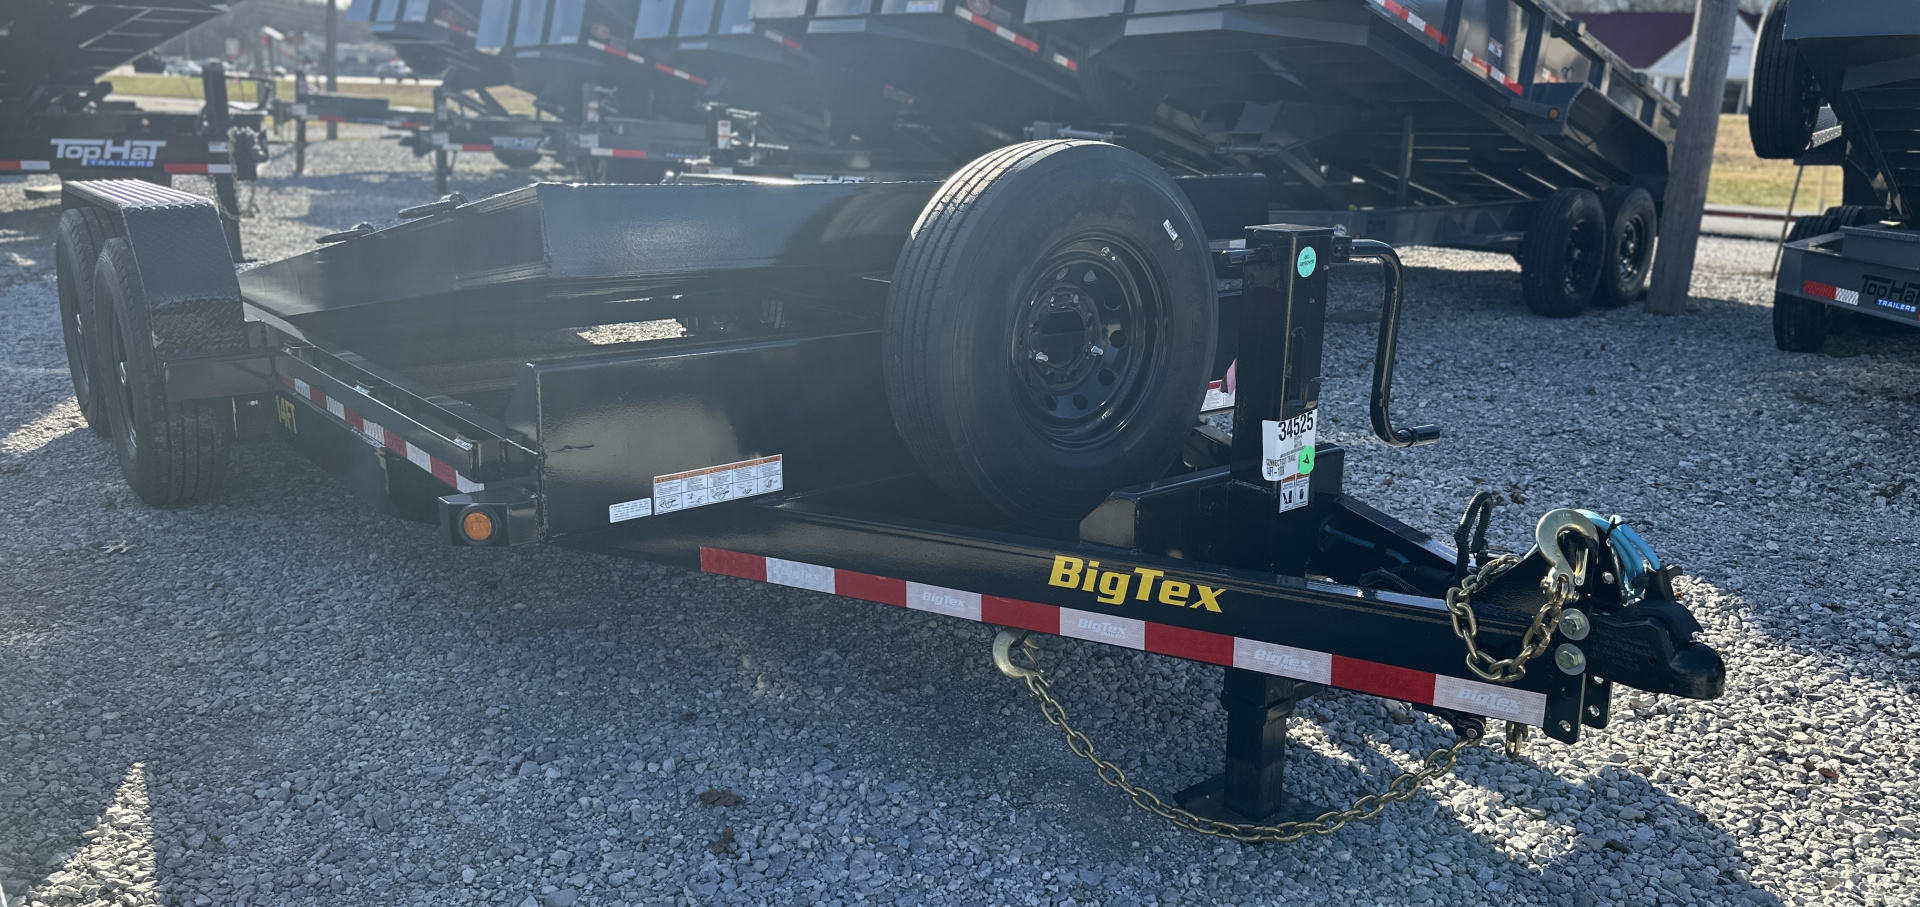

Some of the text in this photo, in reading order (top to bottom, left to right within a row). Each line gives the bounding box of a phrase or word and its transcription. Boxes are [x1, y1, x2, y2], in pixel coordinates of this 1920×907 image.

[89, 159, 154, 167] TRAILERS
[1877, 299, 1917, 313] TRAILERS
[275, 394, 298, 434] 14FT
[1278, 411, 1313, 441] 34525
[1047, 554, 1227, 614] BigTex
[922, 591, 966, 608] BigTex
[1077, 618, 1126, 635] BigTex
[1253, 649, 1310, 669] BigTex
[1457, 688, 1520, 710] BigTex
